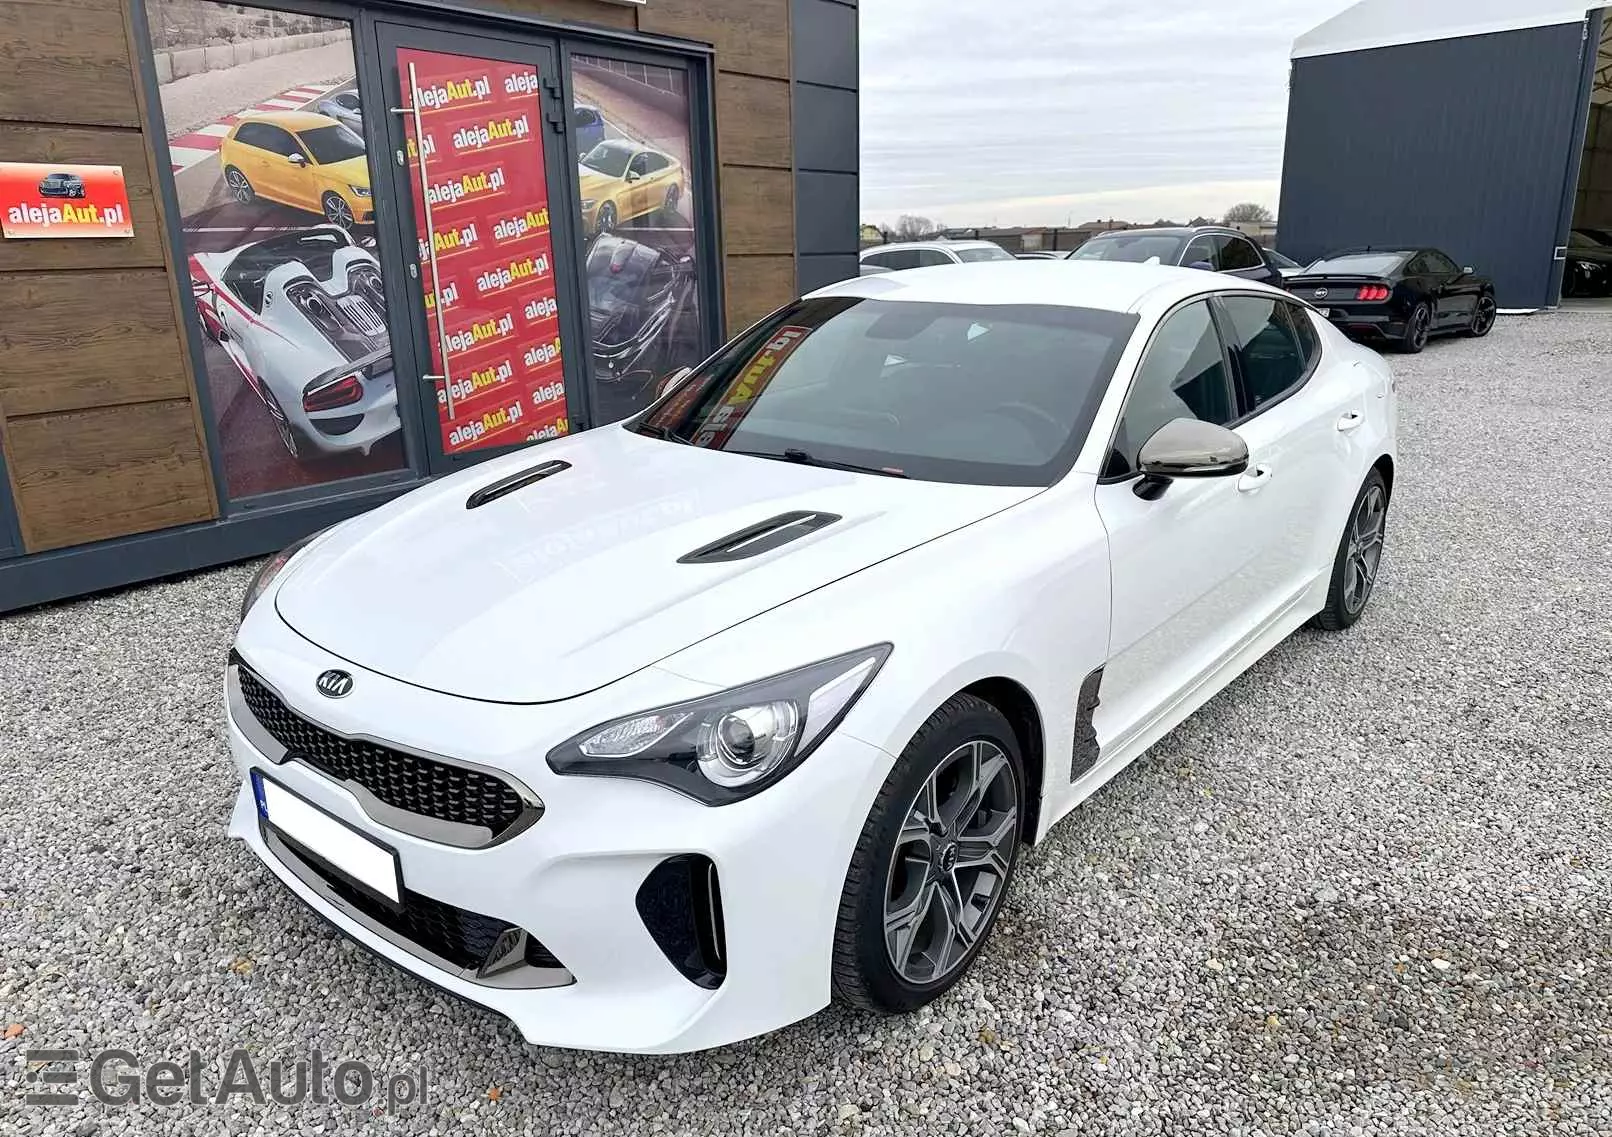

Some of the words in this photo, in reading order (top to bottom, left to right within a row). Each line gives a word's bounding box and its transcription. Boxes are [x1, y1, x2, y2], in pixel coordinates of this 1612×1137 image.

[409, 75, 492, 109] lejaAut.pl
[504, 71, 538, 94] aleja
[452, 115, 530, 148] alejaAut.pl
[425, 167, 506, 204] alejaAut.pl
[8, 203, 124, 226] alejaAut.pl
[476, 253, 550, 291] alejaAut.pl
[524, 296, 558, 320] aleja
[438, 313, 514, 353] lejaAut.pl
[436, 360, 513, 404] aejaAut.pl
[532, 381, 565, 405] aleja
[449, 400, 523, 445] alejaAut.pl
[318, 674, 350, 695] KIA
